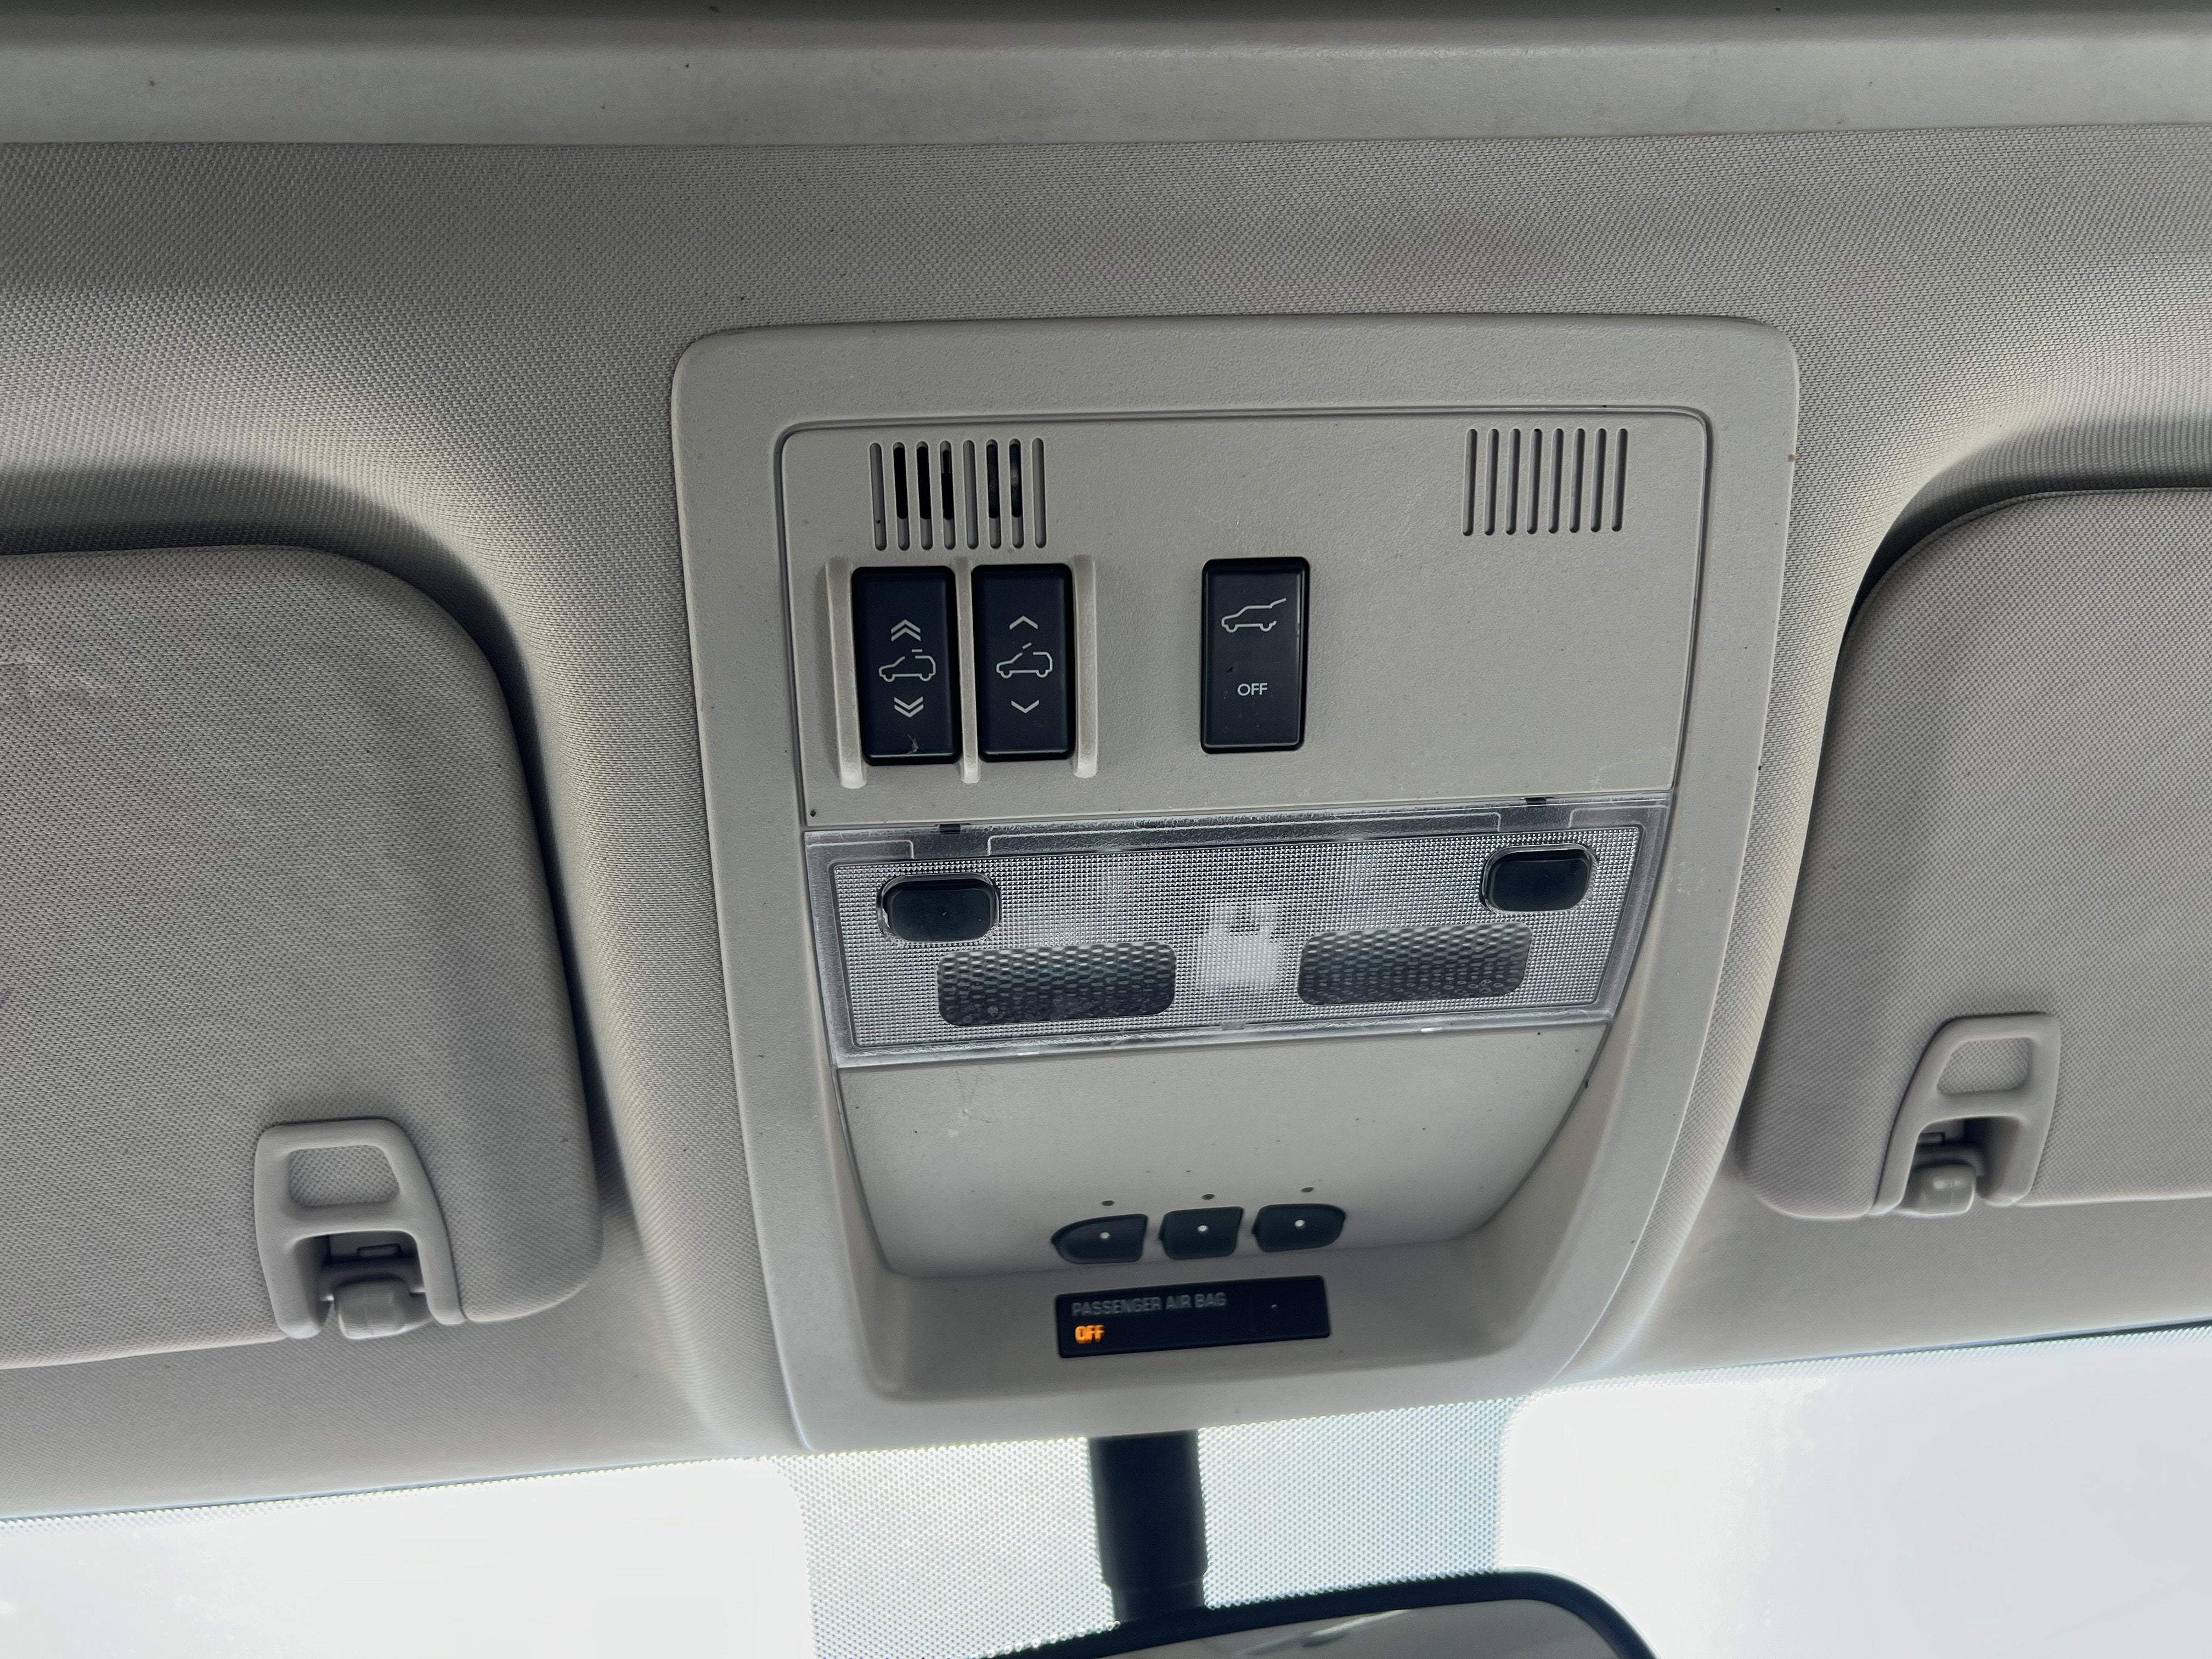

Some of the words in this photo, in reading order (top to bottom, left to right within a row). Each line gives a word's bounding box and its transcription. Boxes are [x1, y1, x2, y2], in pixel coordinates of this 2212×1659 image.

[1237, 682, 1268, 696] OFF
[1071, 1296, 1162, 1317] PASSENGER
[1165, 1294, 1192, 1310] AIR
[1194, 1292, 1227, 1308] BAG
[1075, 1324, 1105, 1344] OFF
